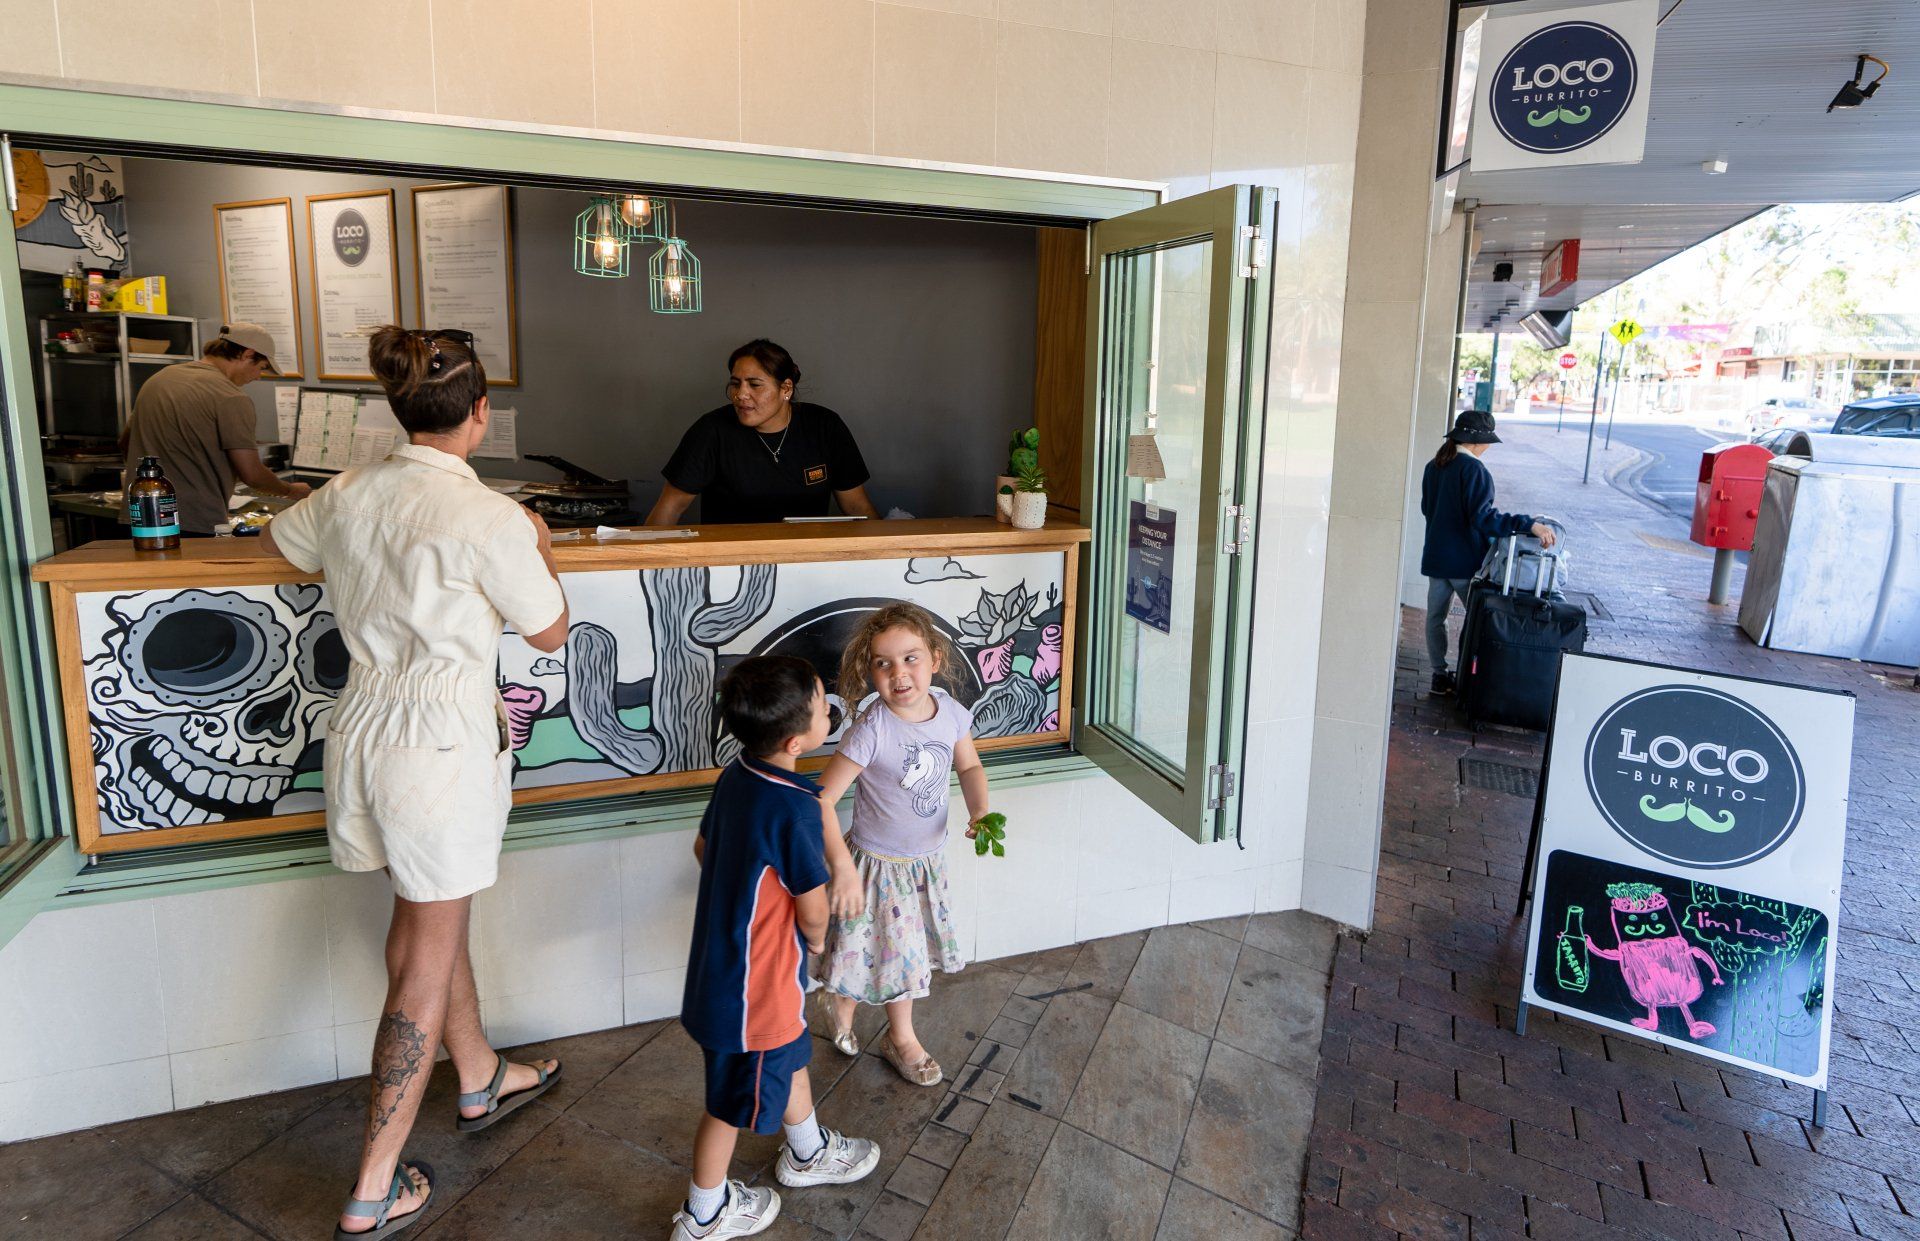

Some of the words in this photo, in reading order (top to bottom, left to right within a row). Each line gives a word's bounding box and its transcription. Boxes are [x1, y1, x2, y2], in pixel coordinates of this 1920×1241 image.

[1512, 57, 1614, 91] LOCO
[1523, 88, 1598, 104] BURRITO
[337, 225, 364, 238] LOCO
[1560, 356, 1577, 366] STOP
[1154, 529, 1168, 541] YOUR
[1141, 536, 1162, 550] DISTANCE
[1617, 727, 1769, 784] LOCO
[1634, 770, 1746, 802] BURRITO
